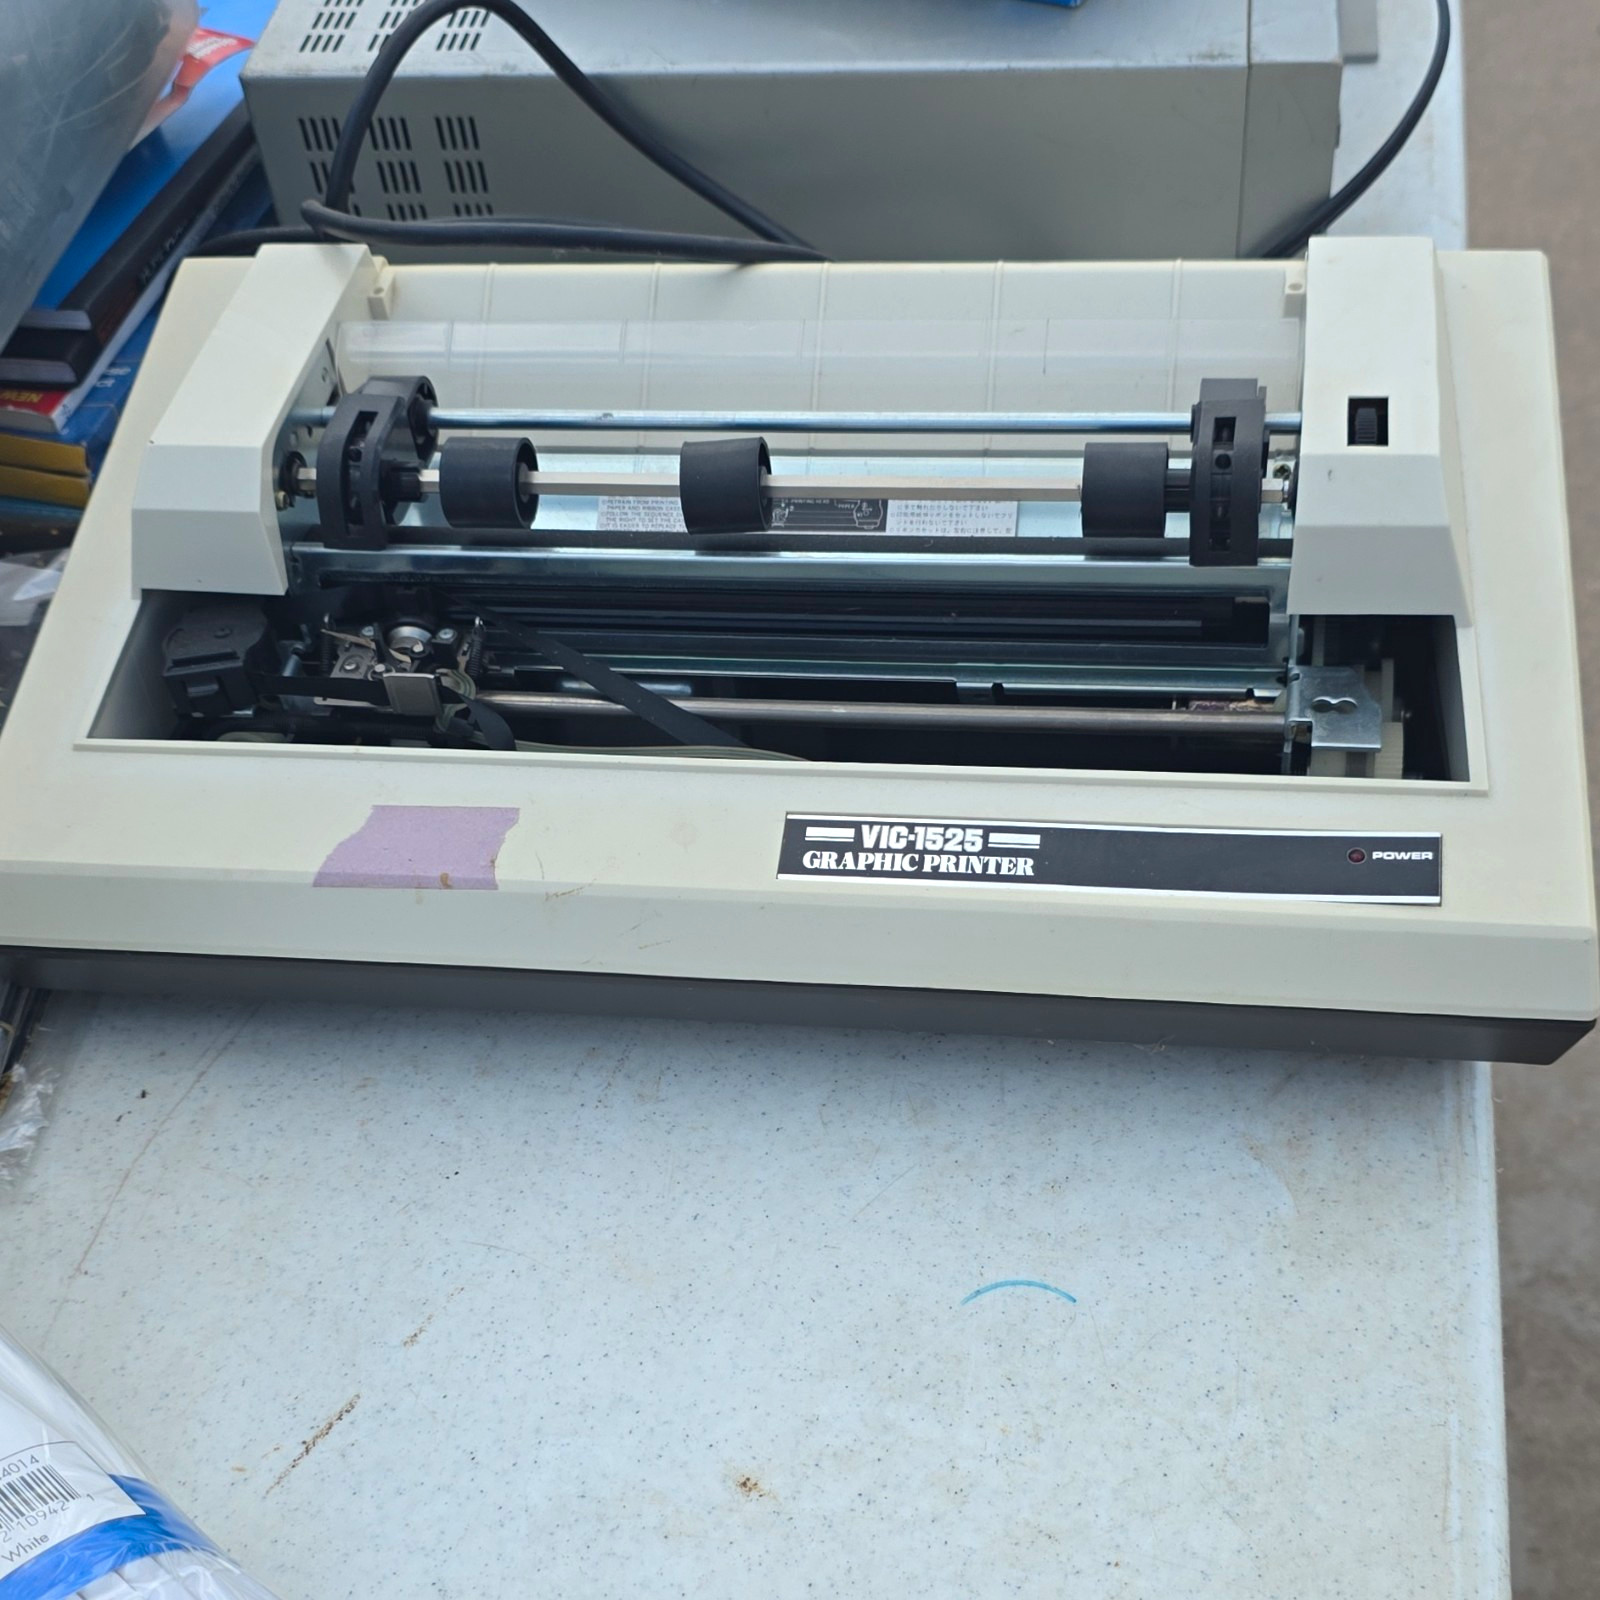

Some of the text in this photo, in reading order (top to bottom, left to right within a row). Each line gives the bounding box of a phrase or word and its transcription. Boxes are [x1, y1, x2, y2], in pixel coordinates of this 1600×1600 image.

[861, 824, 983, 853] VIC-1525
[802, 850, 1035, 876] GRAPHIC PRINTER
[1372, 851, 1433, 860] POWER
[0, 1454, 39, 1480] 4014
[16, 1500, 70, 1531] 10942
[1, 1534, 49, 1563] White
